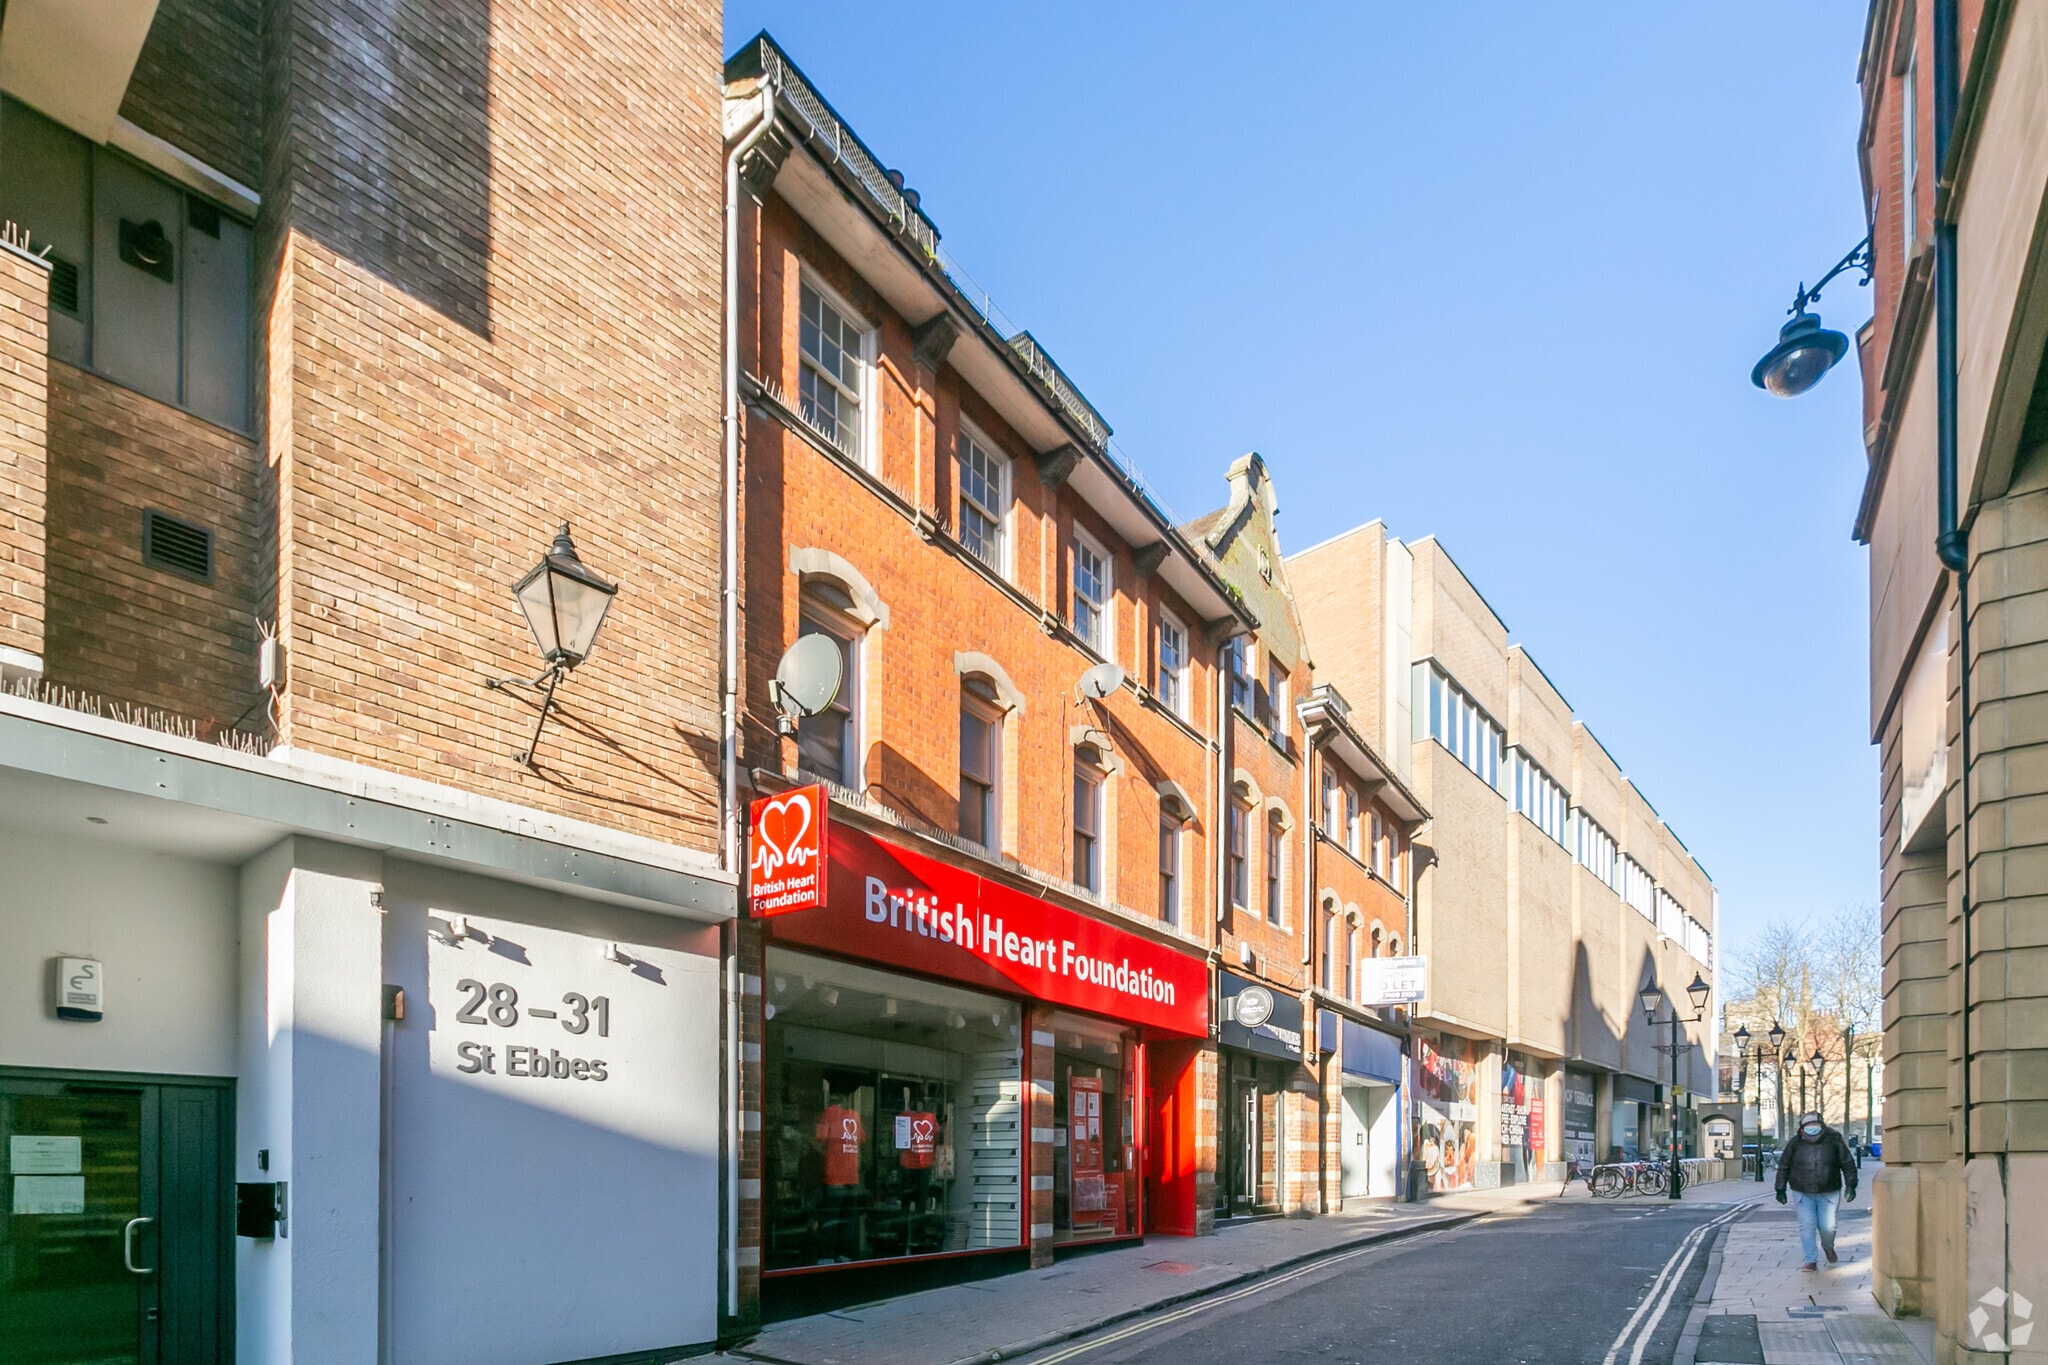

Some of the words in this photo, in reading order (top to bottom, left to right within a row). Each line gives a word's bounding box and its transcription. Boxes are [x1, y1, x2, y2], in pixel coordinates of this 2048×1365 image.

[753, 879, 785, 897] British
[787, 873, 815, 890] Heart
[753, 889, 815, 911] Foundation
[864, 875, 974, 949] British
[982, 913, 1057, 973] Heart
[1061, 940, 1175, 1006] Foundation
[1393, 980, 1416, 990] LET
[456, 1041, 496, 1075] St
[506, 1044, 608, 1082] Ebbes
